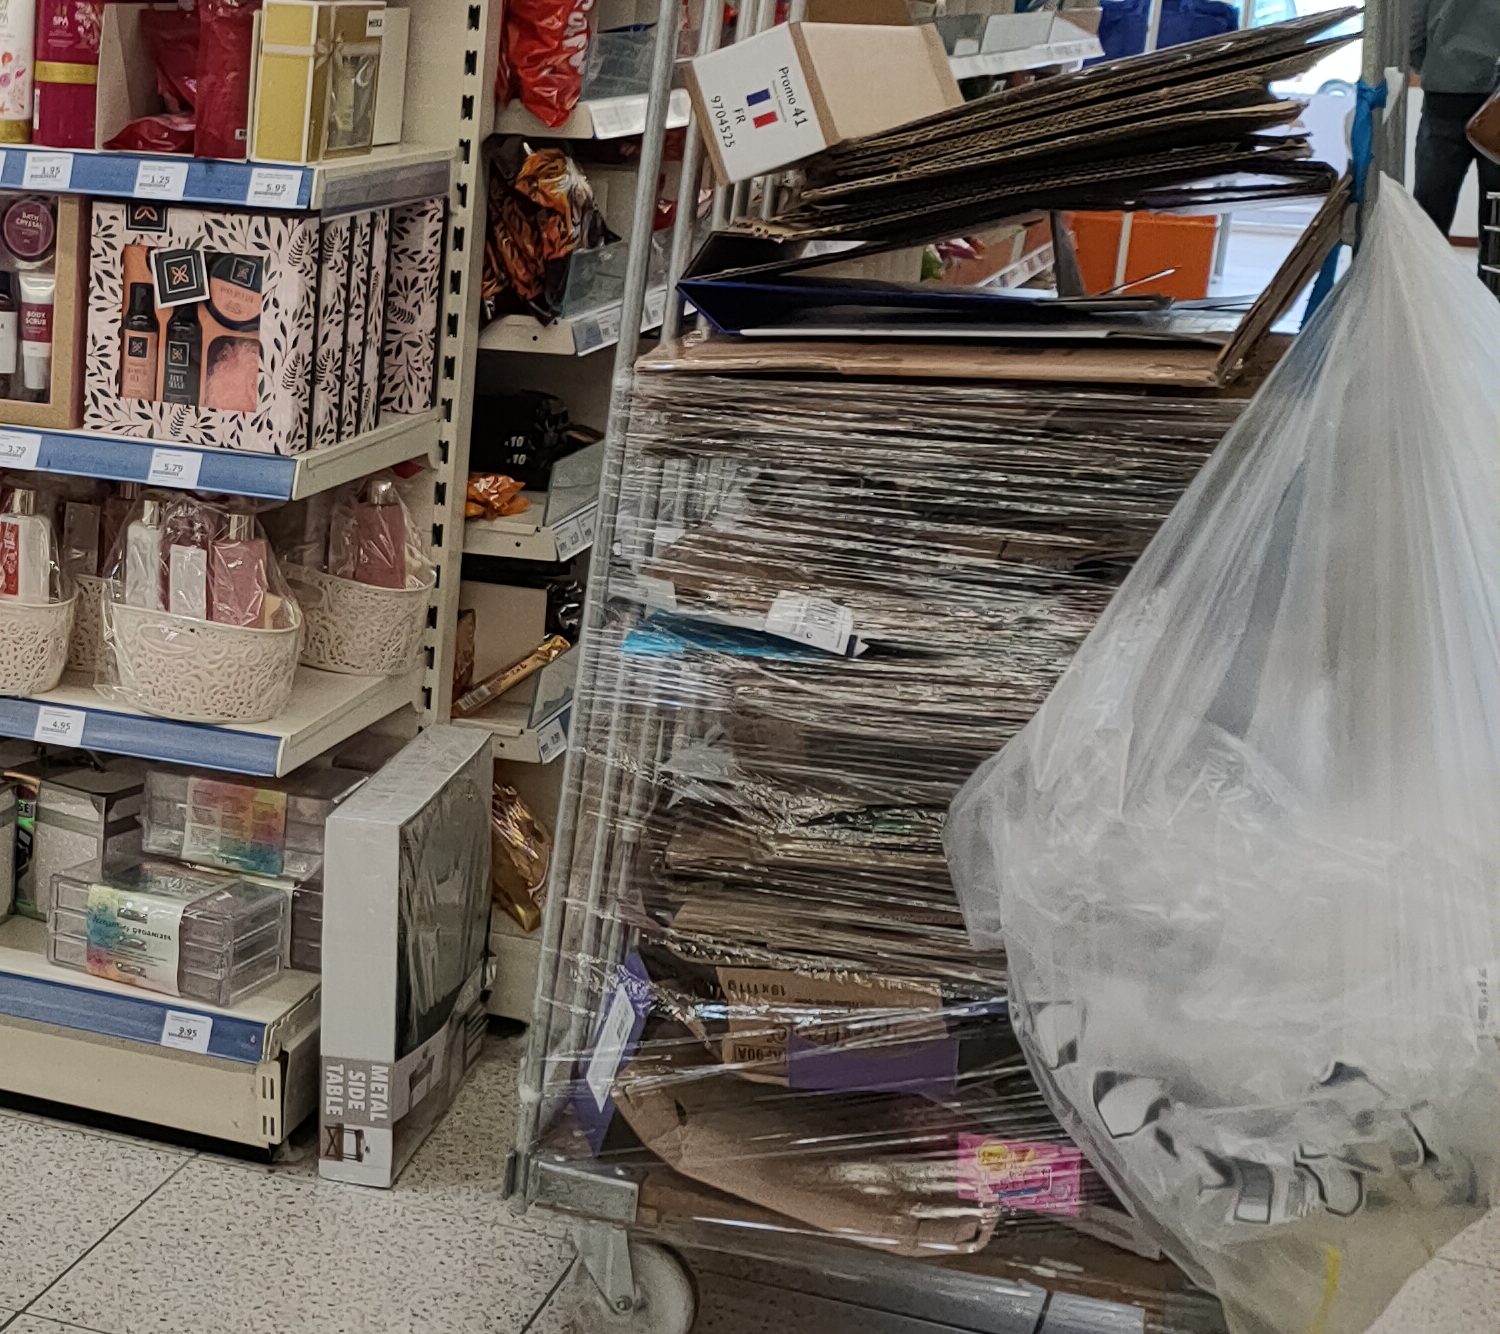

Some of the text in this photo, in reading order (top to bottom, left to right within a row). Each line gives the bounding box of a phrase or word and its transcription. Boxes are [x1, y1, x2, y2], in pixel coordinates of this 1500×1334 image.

[53, 15, 70, 27] SPA
[779, 66, 809, 129] Promo 41
[733, 107, 747, 125] FR
[266, 183, 287, 193] 5.95
[26, 310, 46, 318] BODY
[25, 317, 47, 327] SCRUB
[8, 444, 27, 455] 3.79
[164, 463, 184, 473] 5.79
[52, 720, 72, 731] 4.95
[178, 1026, 198, 1038] 9.95
[325, 1064, 345, 1116] TABLE
[347, 1069, 367, 1112] SIDE
[369, 1064, 389, 1122] METAL
